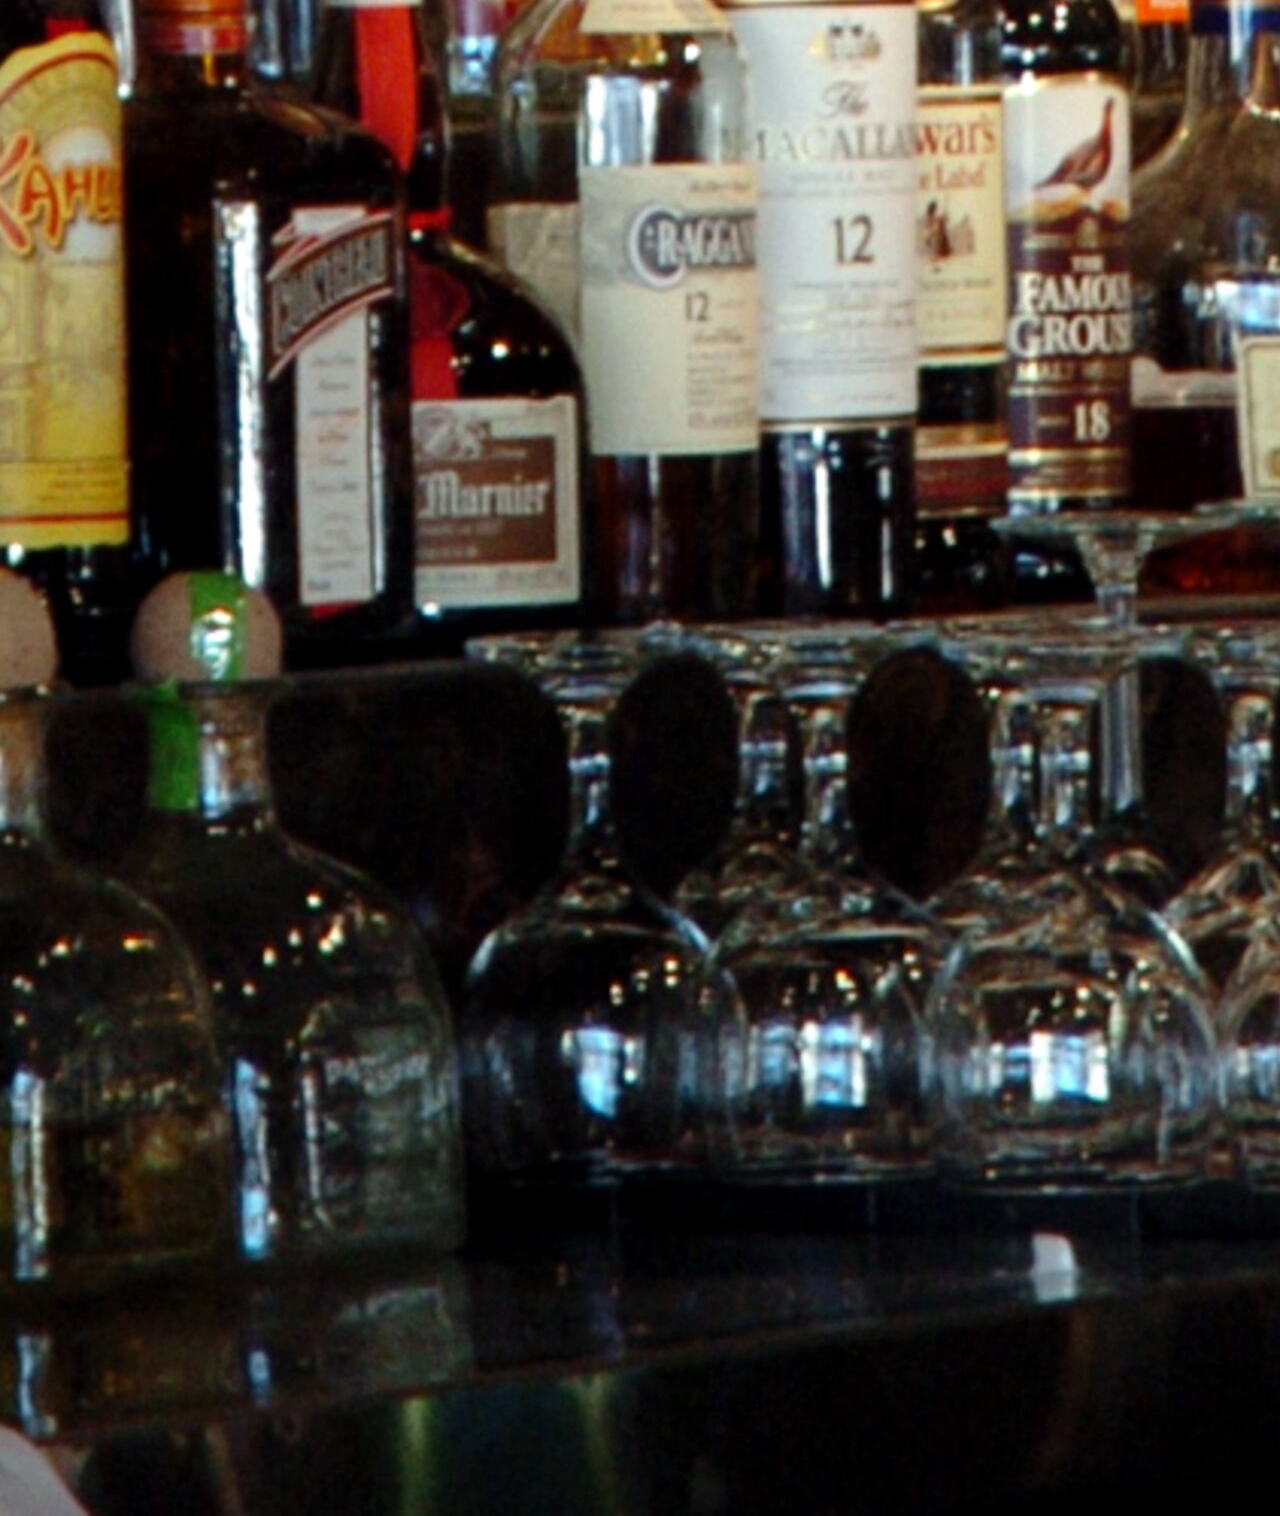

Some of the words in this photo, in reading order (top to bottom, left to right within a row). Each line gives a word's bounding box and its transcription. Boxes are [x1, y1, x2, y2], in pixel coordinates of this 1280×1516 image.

[832, 214, 874, 265] 12
[684, 291, 711, 323] 12
[1073, 402, 1111, 443] 18
